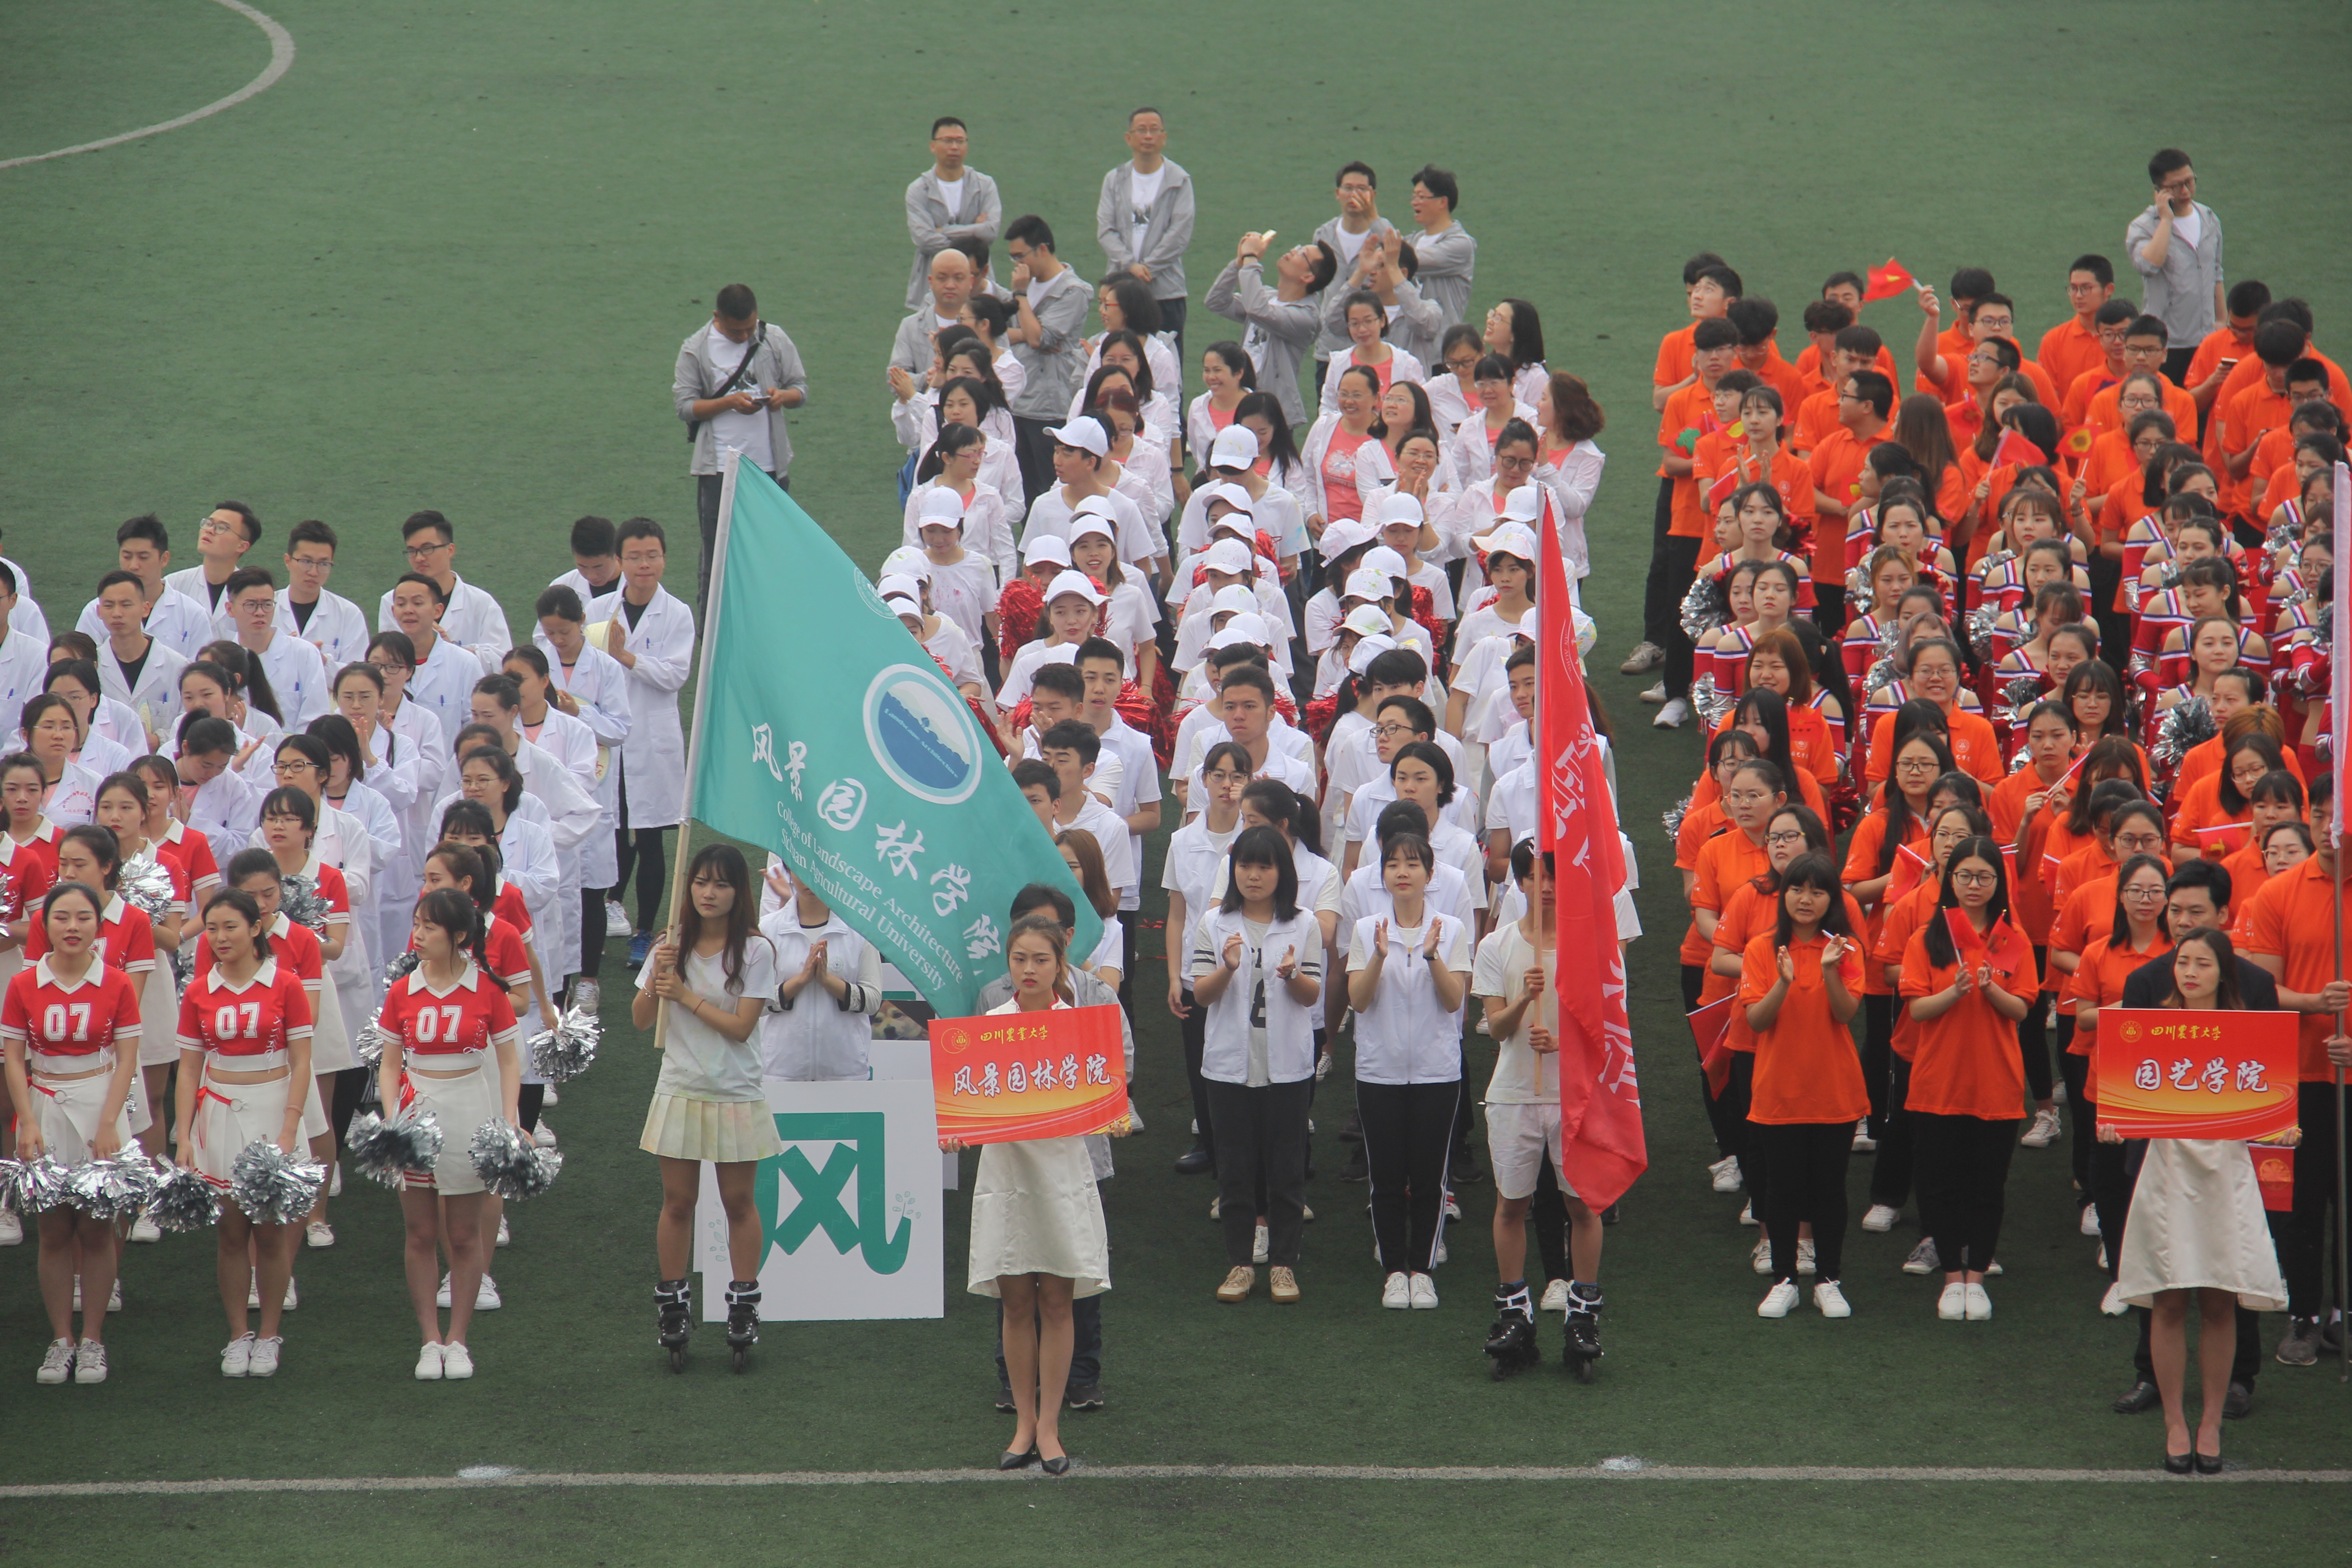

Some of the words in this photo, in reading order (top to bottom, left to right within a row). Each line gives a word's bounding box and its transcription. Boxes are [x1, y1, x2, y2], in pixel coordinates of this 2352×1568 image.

[777, 801, 801, 838] College
[801, 832, 812, 848] of
[813, 837, 882, 899] Landscape
[883, 898, 964, 984] Architecture
[810, 858, 877, 922] Agricultural
[877, 915, 946, 991] University
[44, 1003, 91, 1041] 07
[215, 1002, 260, 1040] 07
[415, 1004, 462, 1043] 07
[953, 1053, 1111, 1098] 风景园林学院
[2135, 1057, 2269, 1093] 园艺学院
